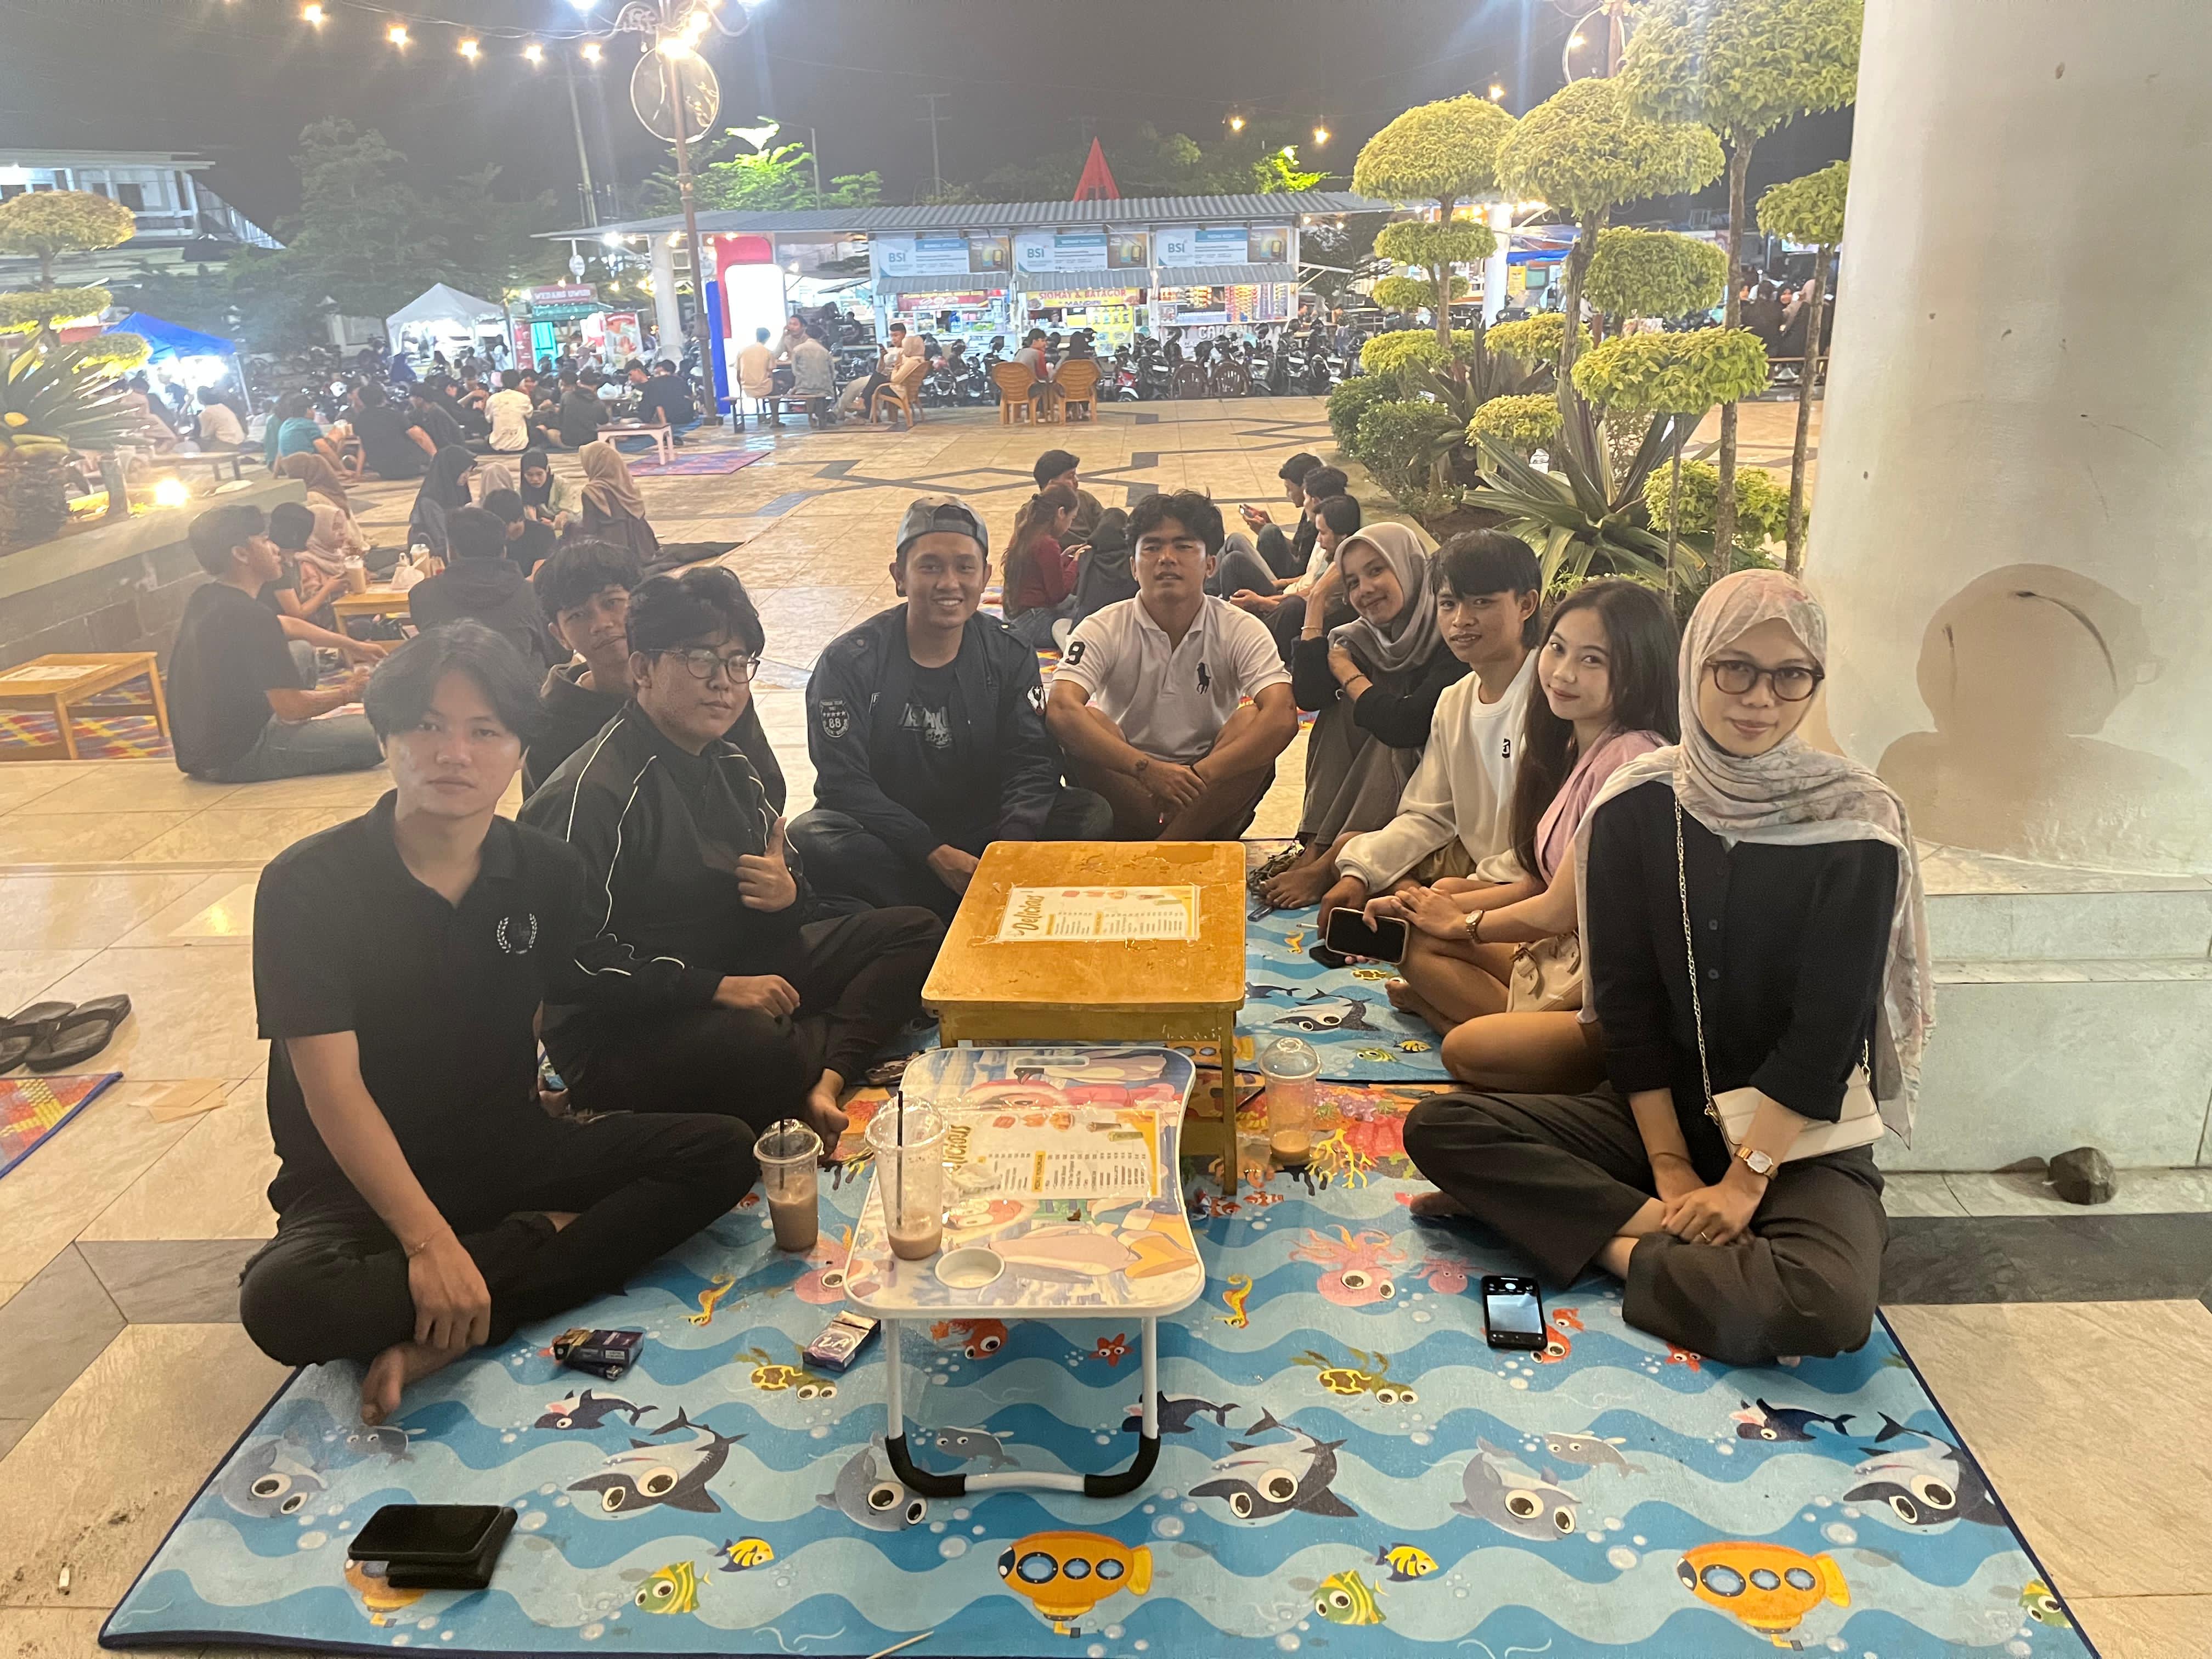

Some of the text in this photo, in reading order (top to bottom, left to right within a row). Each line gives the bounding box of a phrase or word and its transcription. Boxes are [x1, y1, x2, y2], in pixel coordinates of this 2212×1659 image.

[1027, 248, 1045, 258] BSI
[1167, 242, 1185, 253] BSI
[888, 252, 905, 262] BSI
[1065, 641, 1086, 666] 9
[829, 718, 842, 729] 88
